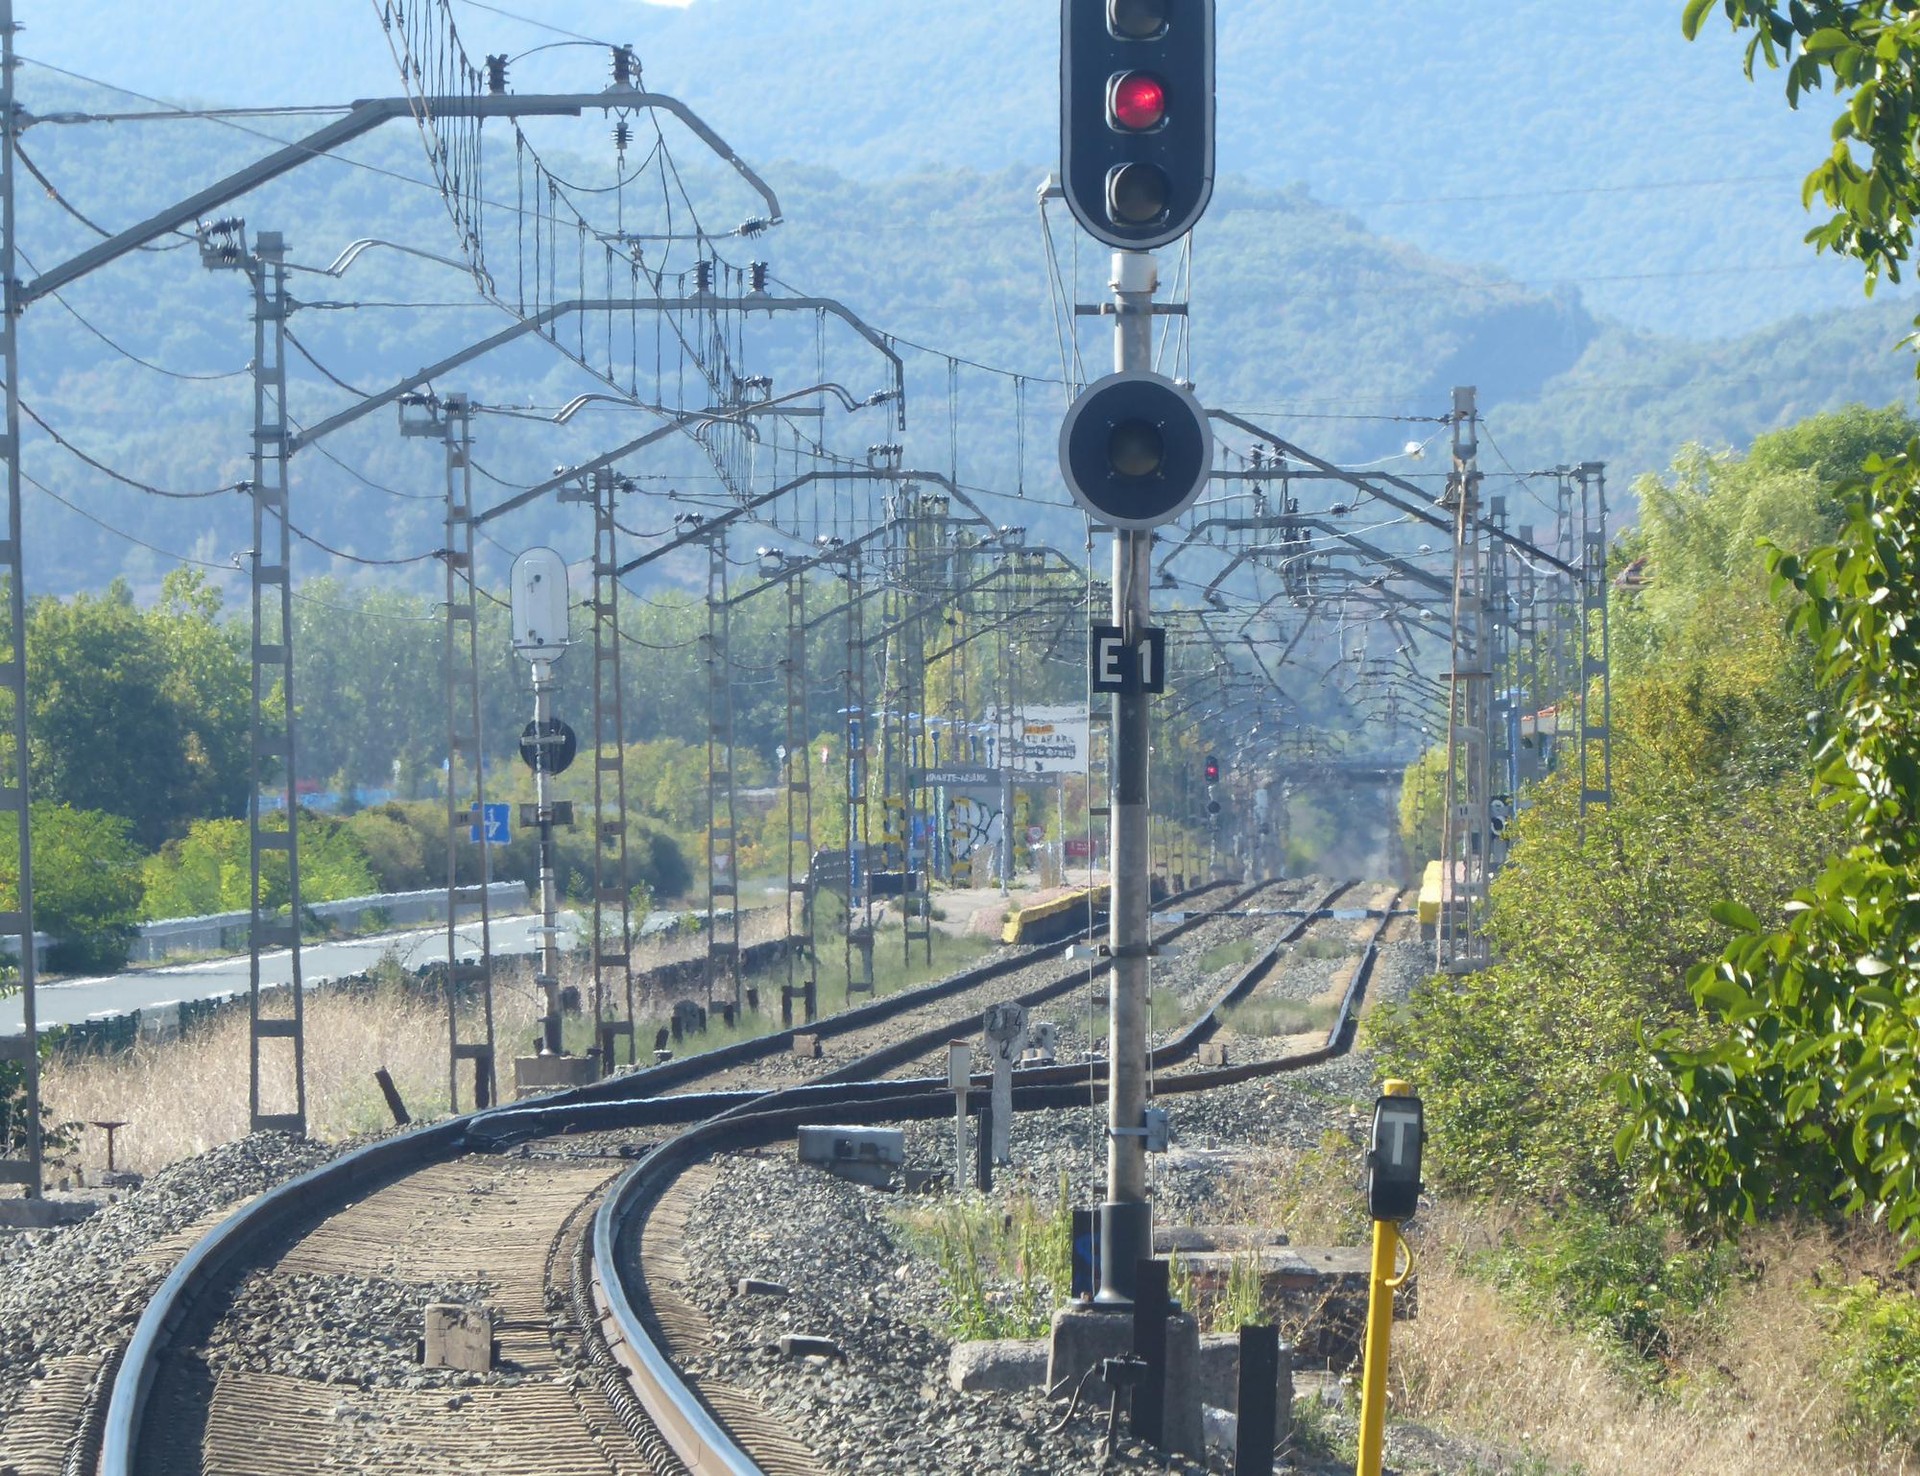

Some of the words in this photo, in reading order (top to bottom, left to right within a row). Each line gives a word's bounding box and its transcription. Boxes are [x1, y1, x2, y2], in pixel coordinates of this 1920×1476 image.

[1100, 638, 1122, 682] E
[1138, 640, 1151, 683] 1
[1382, 1112, 1417, 1165] T
